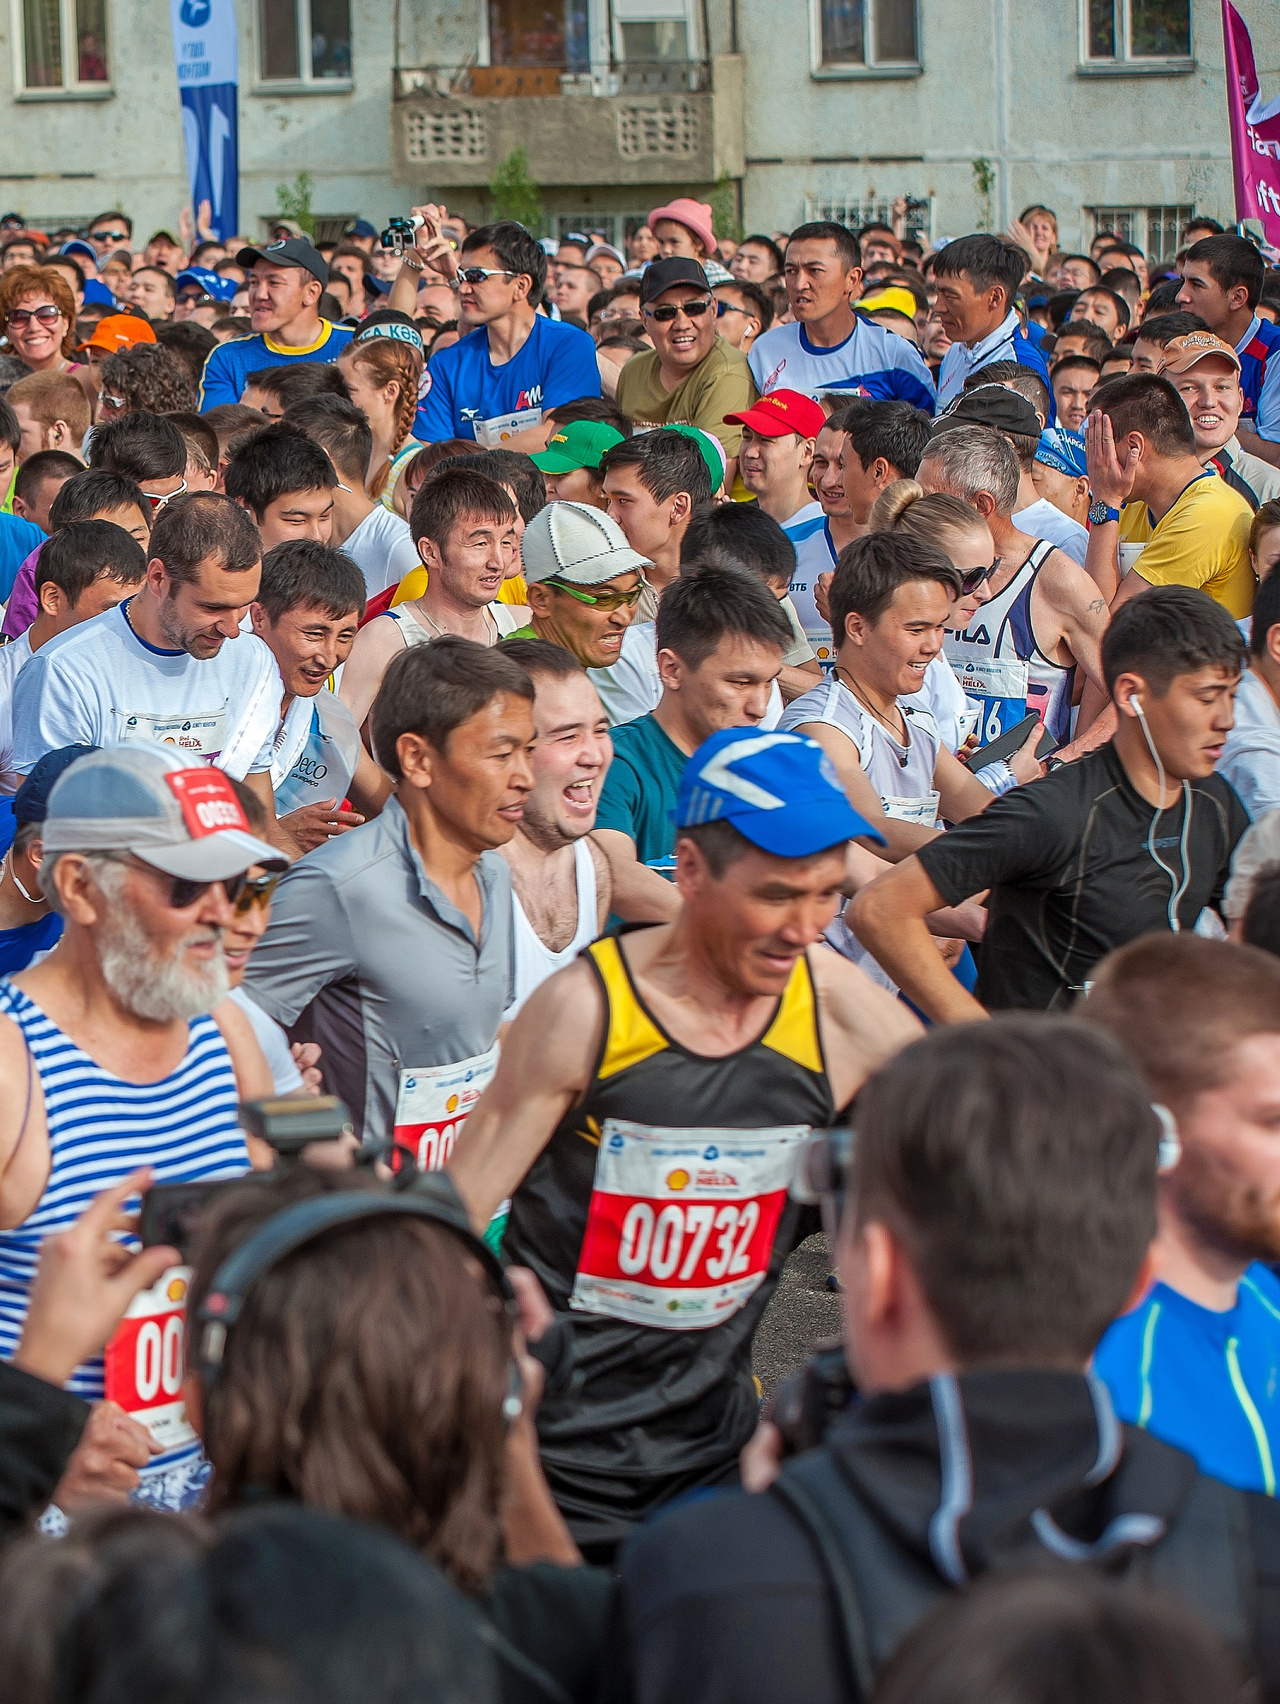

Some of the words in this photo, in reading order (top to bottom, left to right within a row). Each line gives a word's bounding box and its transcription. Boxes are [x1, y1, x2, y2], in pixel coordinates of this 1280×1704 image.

[790, 583, 807, 591] ВТБ
[962, 677, 987, 690] HELIX
[178, 738, 202, 749] HELIX
[617, 1200, 761, 1281] 00732
